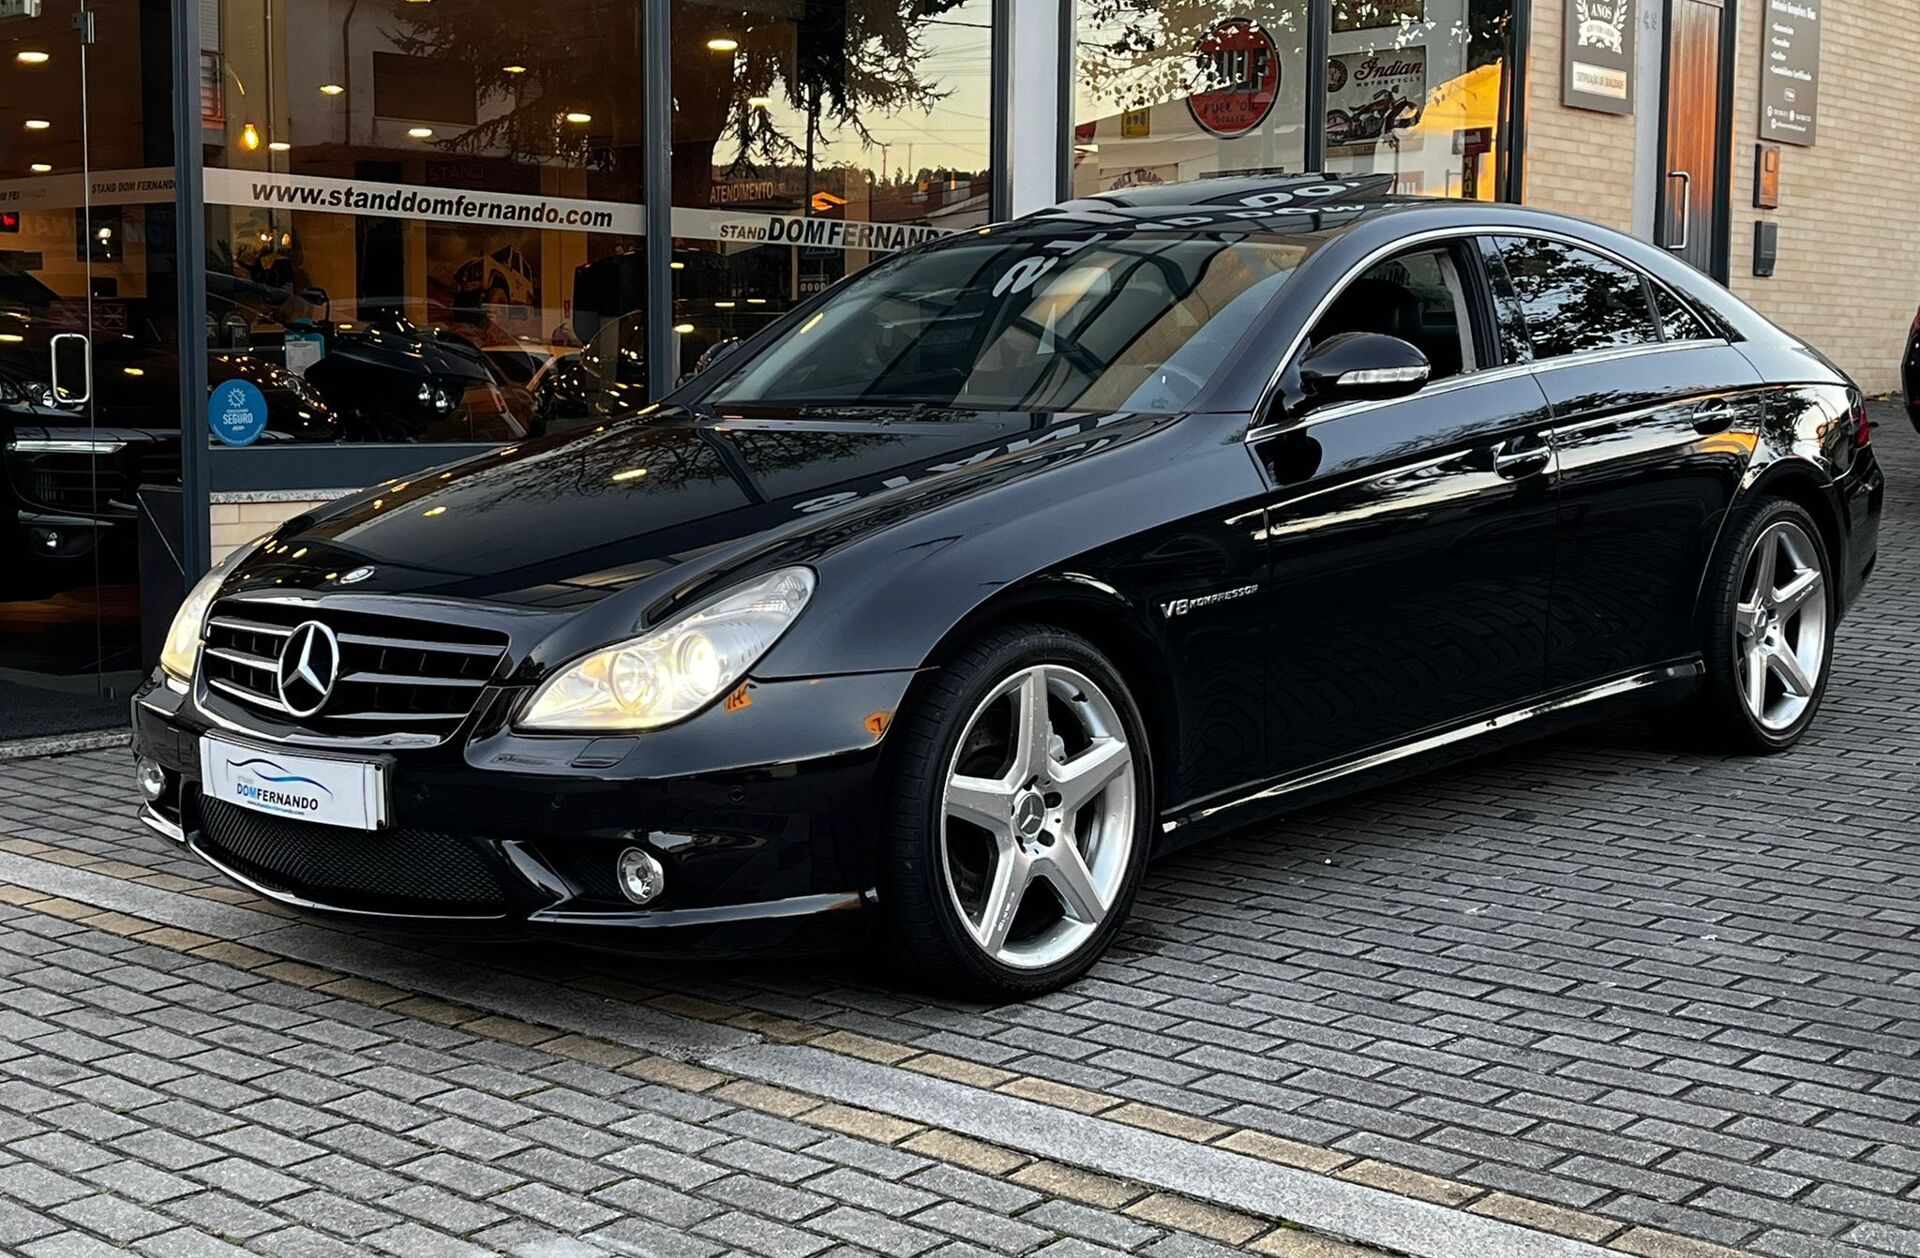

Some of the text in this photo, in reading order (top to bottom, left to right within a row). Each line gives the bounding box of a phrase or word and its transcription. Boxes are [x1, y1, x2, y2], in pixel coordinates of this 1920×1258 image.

[1353, 57, 1423, 80] Indian
[1355, 76, 1421, 87] MOTORCYCLE
[1204, 102, 1258, 114] FUEL OIL
[91, 179, 176, 194] STAND DOM FERNAND
[708, 181, 774, 203] ATENDIMENTO
[251, 182, 613, 228] www.standdomfernando.com
[720, 224, 767, 241] STAND
[827, 221, 953, 250] FERNAND
[222, 412, 254, 425] SEGURO
[1160, 598, 1189, 618] V8
[236, 783, 319, 811] DOMFERNANDO
